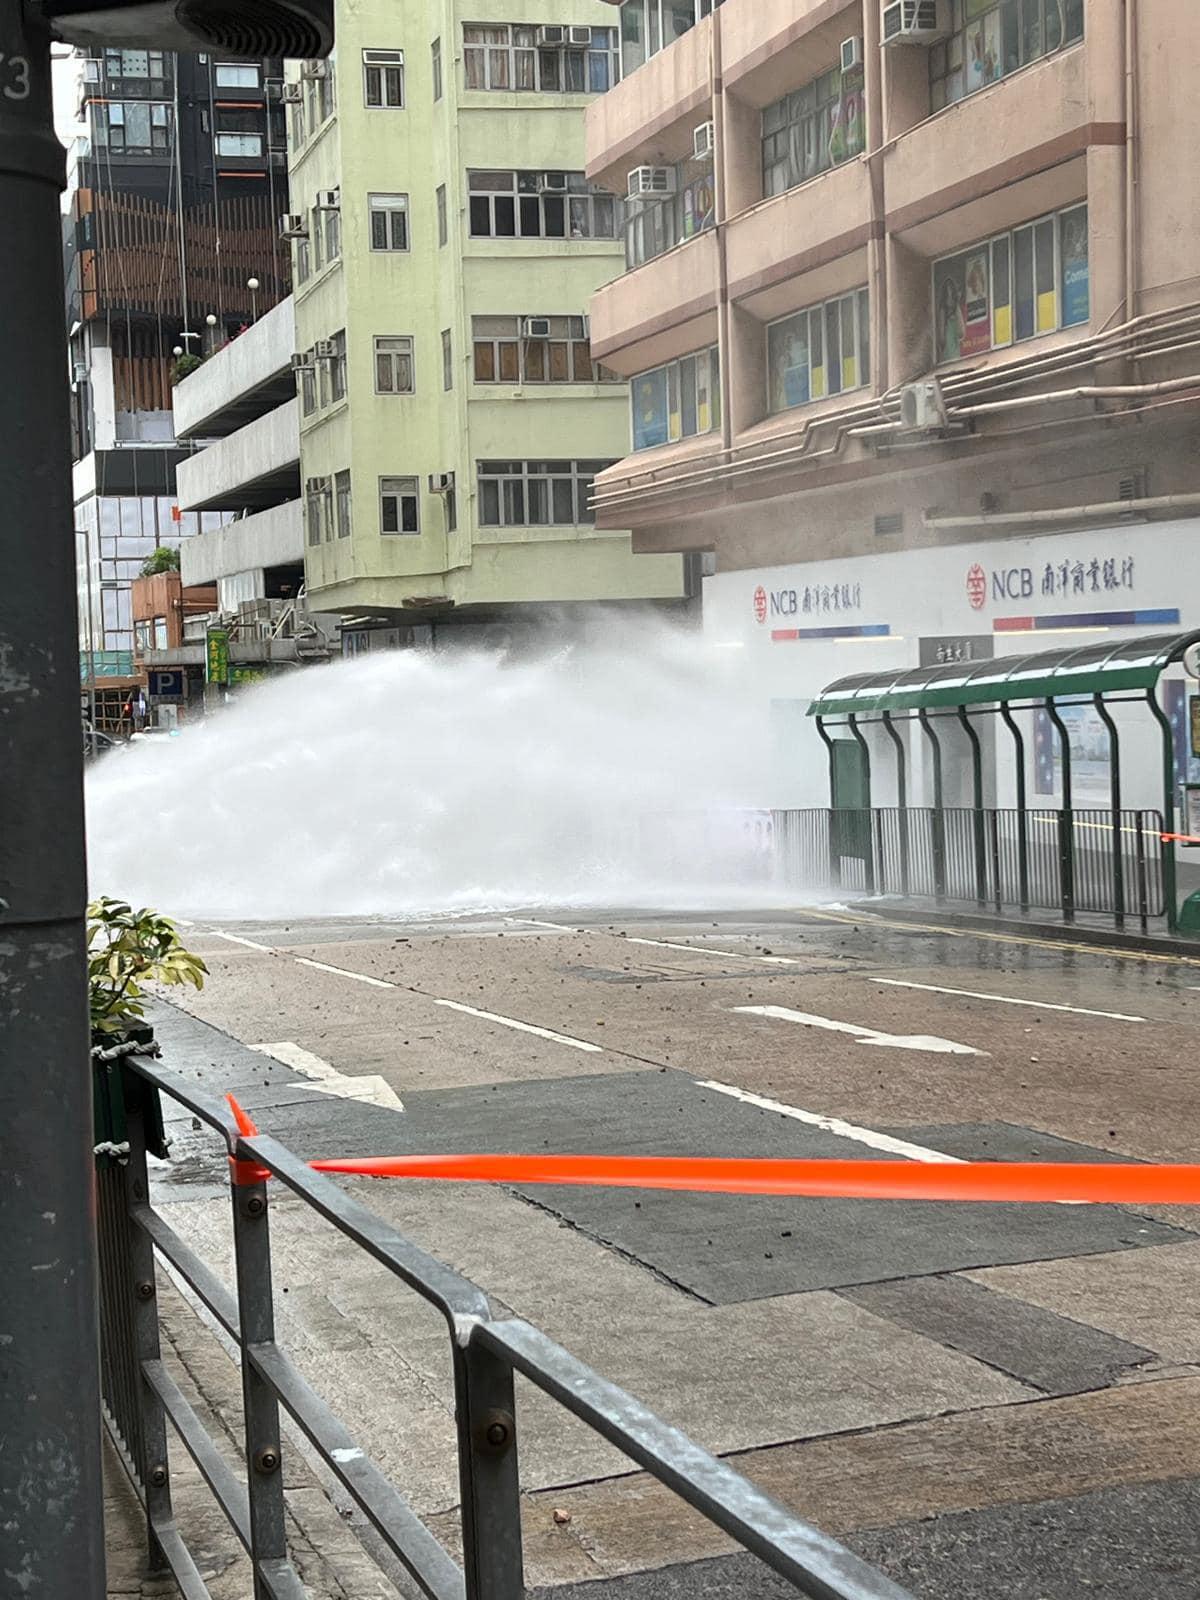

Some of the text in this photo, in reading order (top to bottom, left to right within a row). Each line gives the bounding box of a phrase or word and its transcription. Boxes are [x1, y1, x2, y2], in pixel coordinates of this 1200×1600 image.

[0, 53, 30, 99] 3
[992, 568, 1033, 600] NCB
[770, 590, 797, 615] NCB
[157, 672, 175, 694] P
